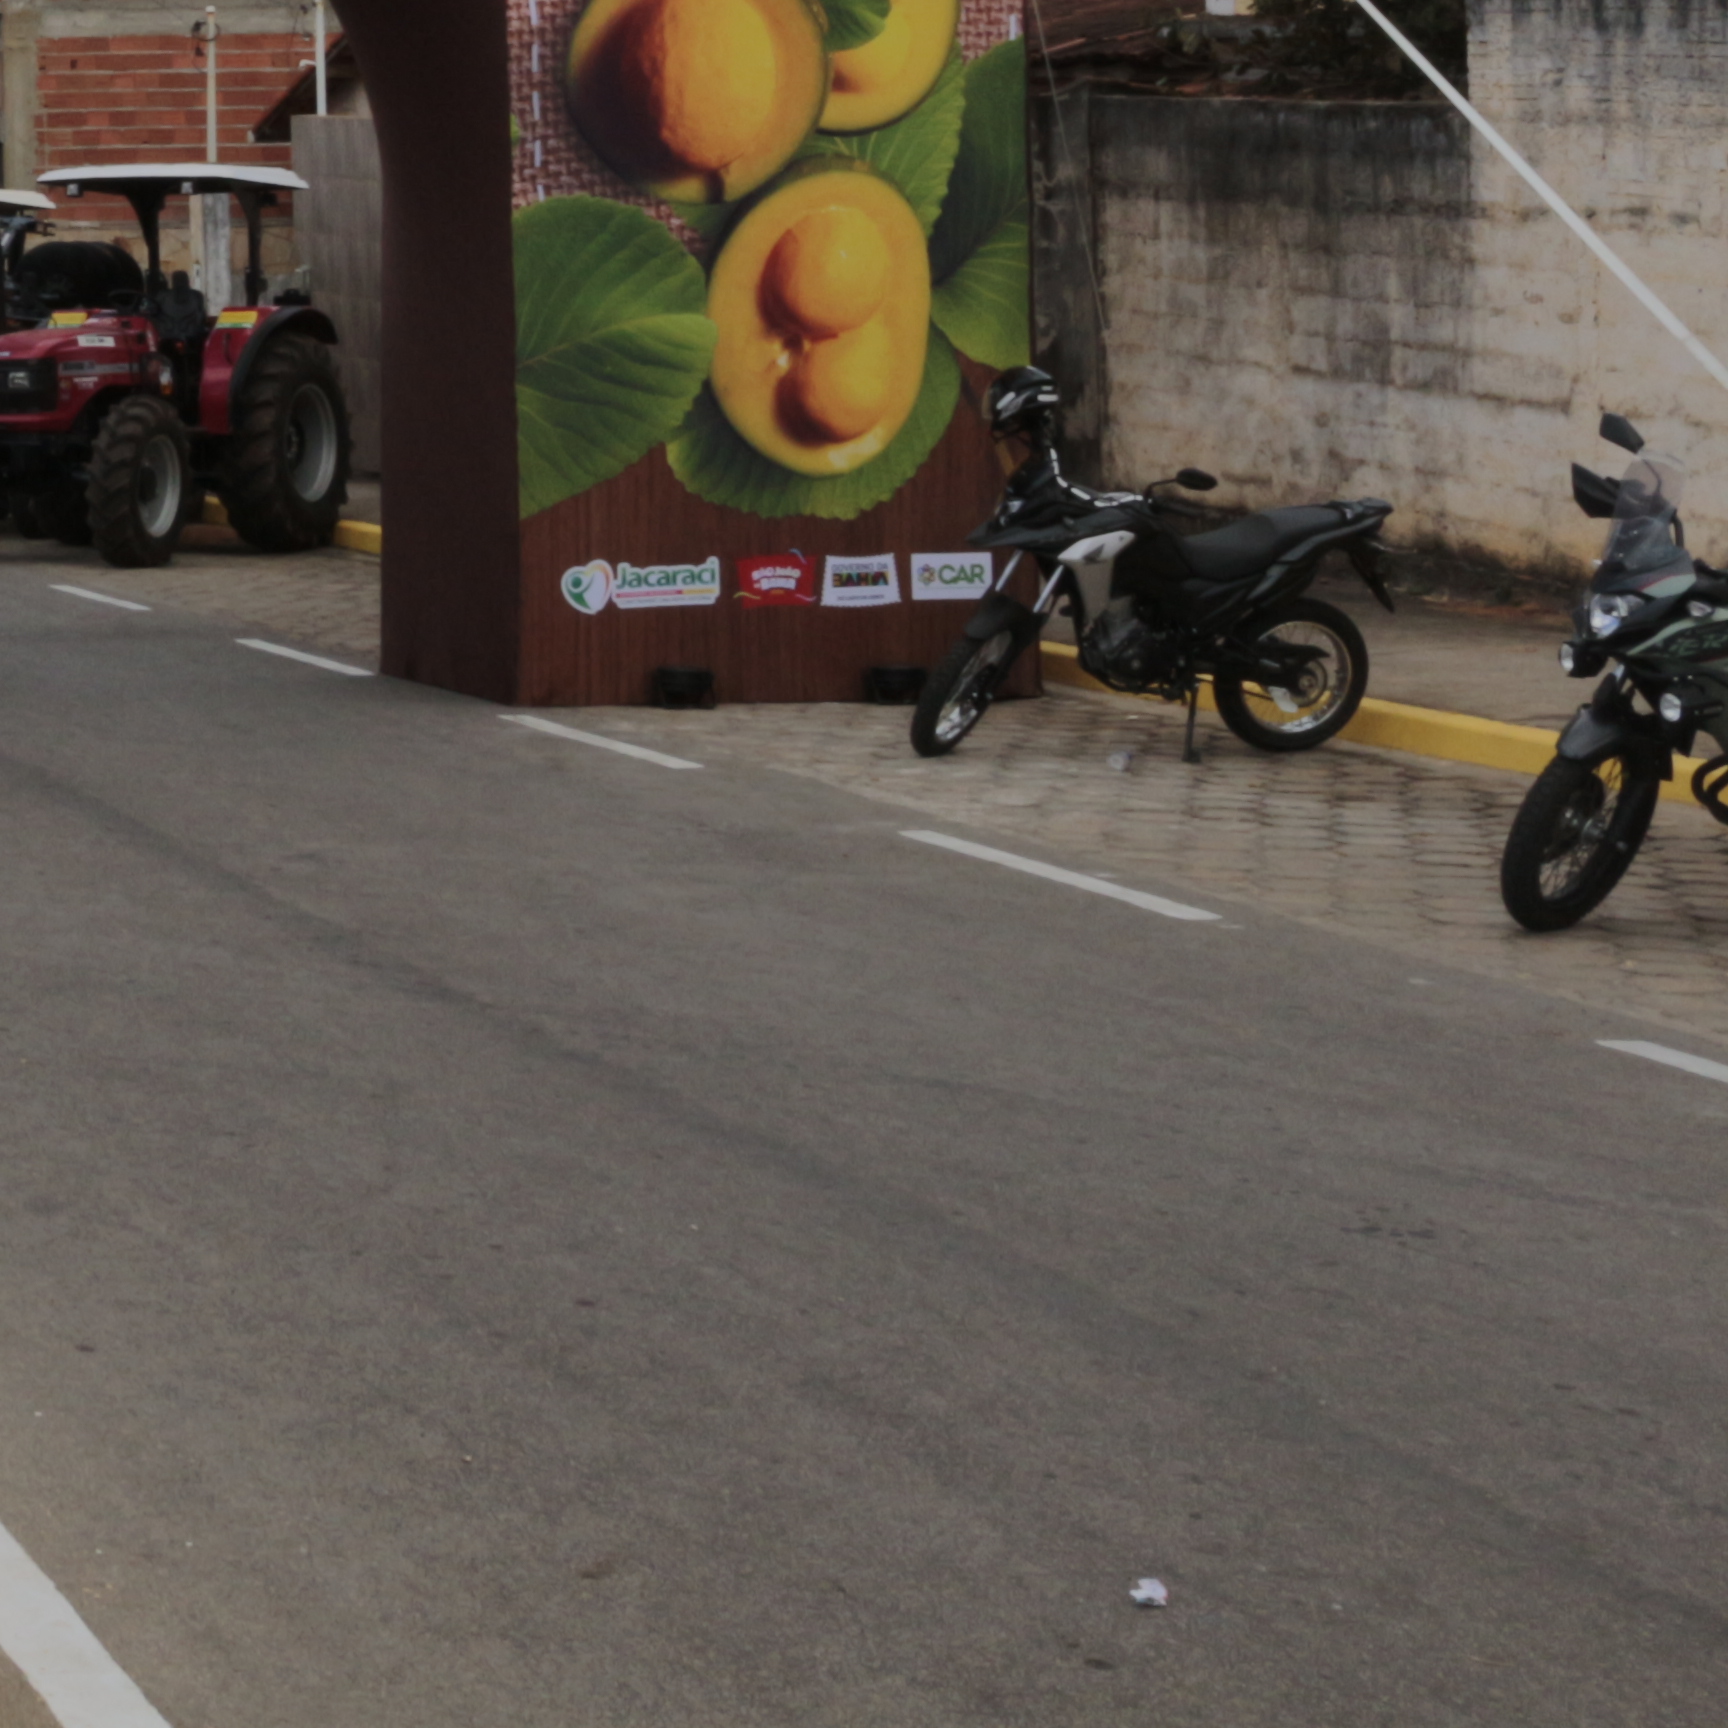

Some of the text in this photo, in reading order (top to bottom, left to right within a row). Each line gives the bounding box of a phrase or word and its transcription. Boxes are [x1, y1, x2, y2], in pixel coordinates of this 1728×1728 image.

[616, 565, 716, 589] Jacaraci
[833, 571, 889, 587] BAHIA
[938, 563, 985, 584] CAR
